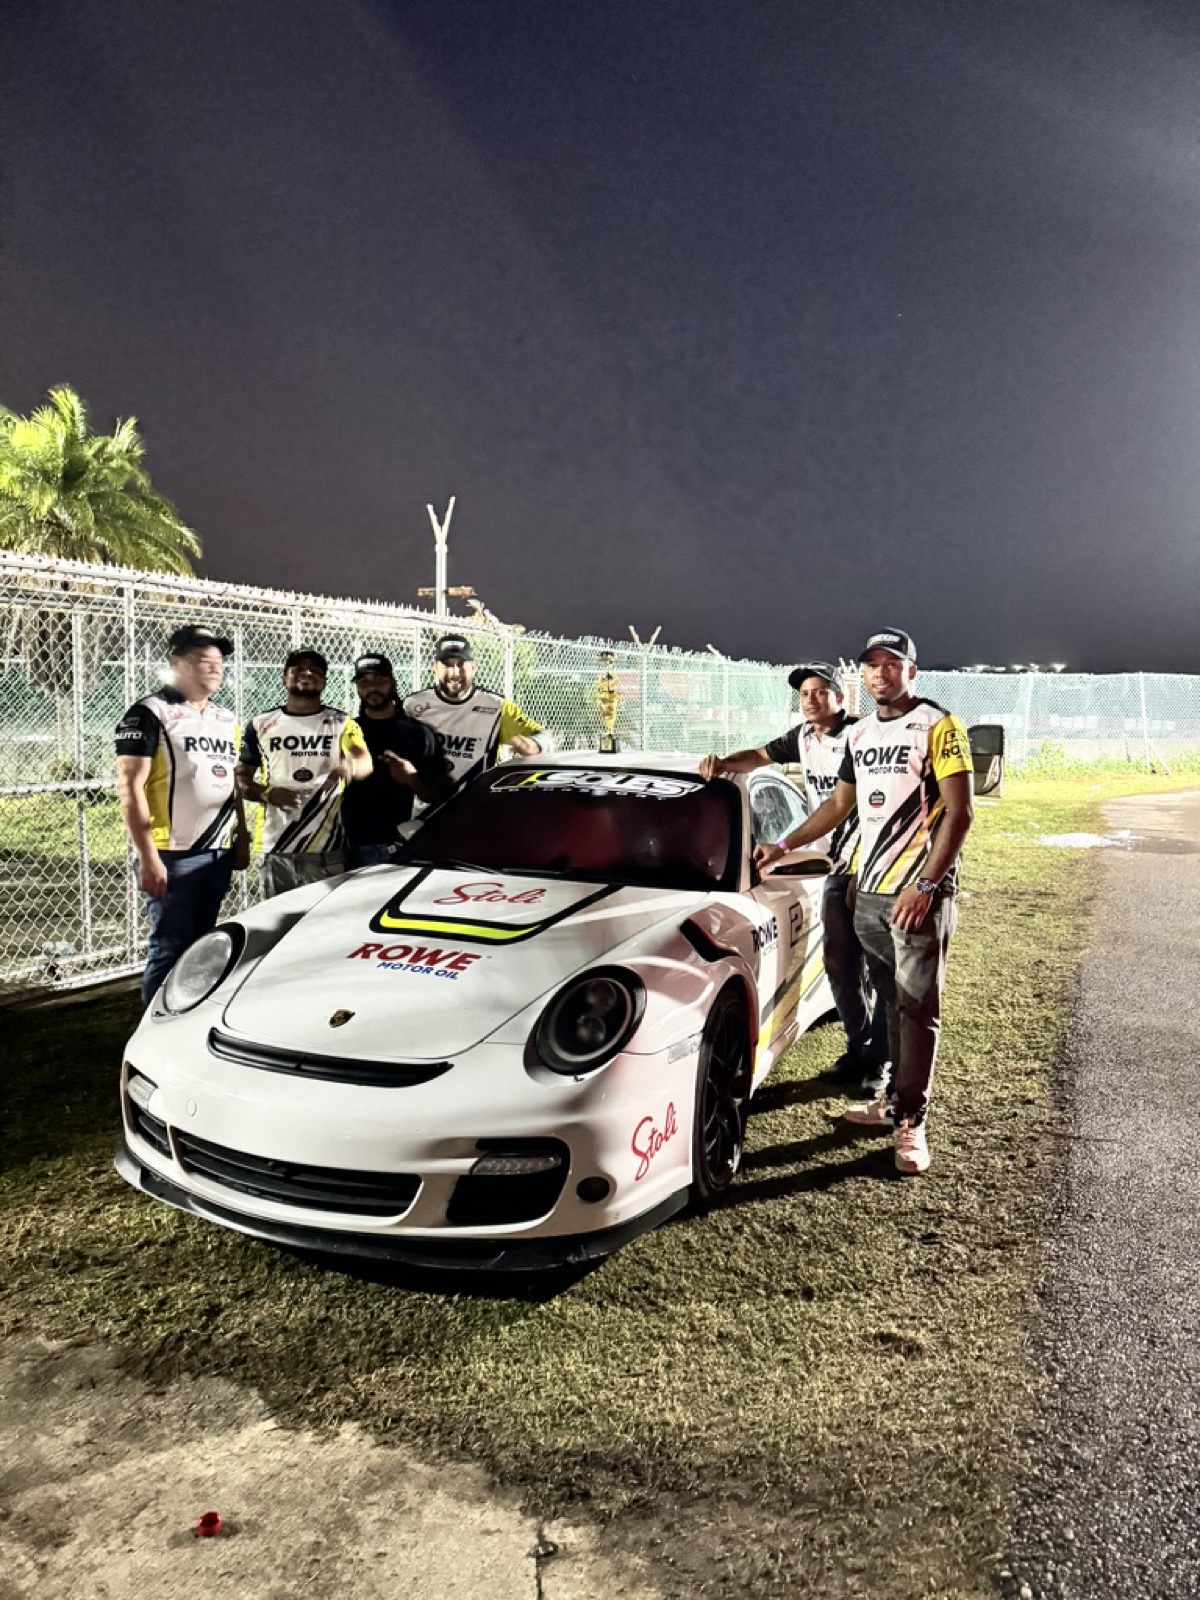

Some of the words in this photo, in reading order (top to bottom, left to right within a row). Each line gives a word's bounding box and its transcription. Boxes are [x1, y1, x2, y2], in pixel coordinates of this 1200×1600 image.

[184, 736, 237, 756] ROWE
[269, 735, 333, 752] ROWE
[433, 732, 478, 752] OWE
[854, 745, 912, 767] ROWE
[868, 766, 892, 775] MOTOR
[893, 766, 909, 774] OIL
[433, 882, 547, 905] Stoli
[347, 942, 482, 971] ROWE
[377, 961, 434, 975] MOTOR
[437, 970, 459, 980] OIL
[630, 1101, 679, 1181] Stoli
